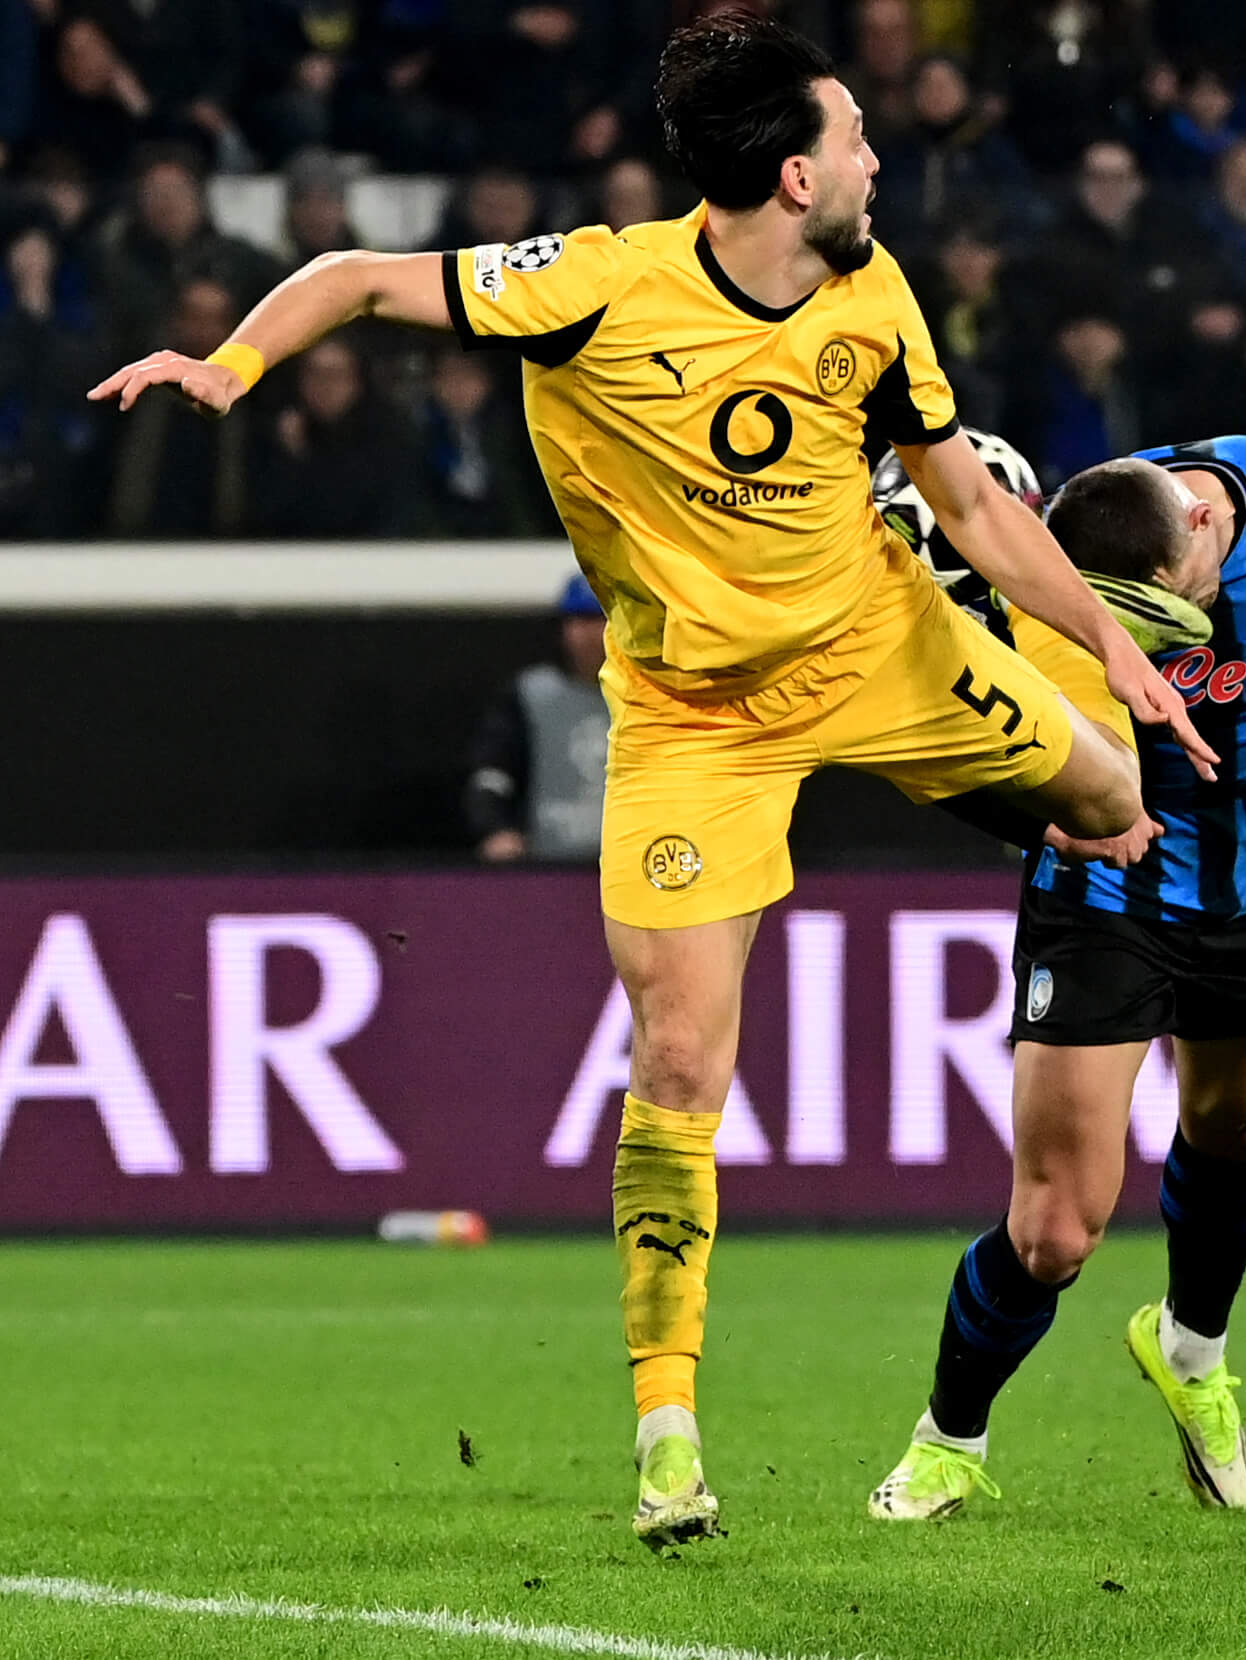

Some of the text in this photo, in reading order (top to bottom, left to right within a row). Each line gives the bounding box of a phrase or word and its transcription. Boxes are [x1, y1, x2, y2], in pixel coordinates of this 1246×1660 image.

[822, 347, 850, 379] BVB
[682, 480, 814, 507] vodafone
[951, 664, 1023, 737] 5
[653, 842, 693, 874] BVB
